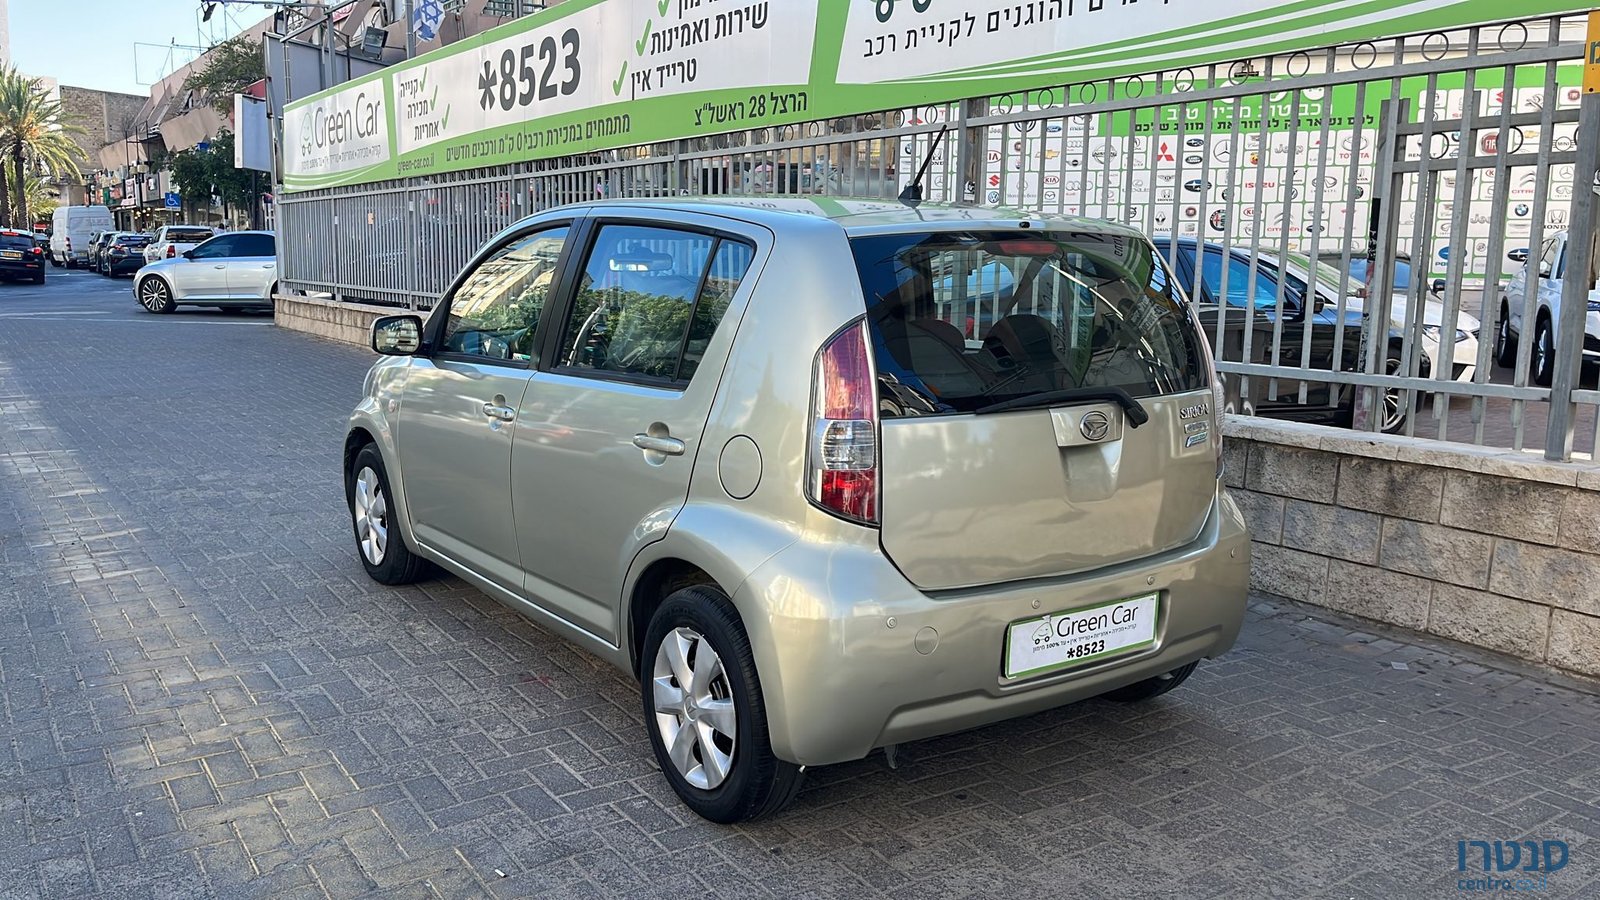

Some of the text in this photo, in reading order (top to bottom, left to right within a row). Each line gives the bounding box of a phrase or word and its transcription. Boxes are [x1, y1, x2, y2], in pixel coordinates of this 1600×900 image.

[714, 1, 768, 40] שירות
[905, 12, 976, 49] לקניית
[650, 18, 710, 56] ואמינות
[864, 33, 896, 57] רכב
[400, 78, 418, 99] קנייה
[630, 58, 697, 100] טרייד אין
[407, 99, 429, 119] מכירה
[749, 95, 766, 118] 28
[770, 91, 807, 114] הרצל
[1258, 103, 1291, 119] טו
[1299, 103, 1332, 116] כב
[315, 92, 380, 149] Green Car
[1167, 107, 1198, 120] טב
[1284, 118, 1301, 129] ק
[1348, 115, 1374, 125] לם
[414, 120, 440, 141] אחריות
[546, 124, 583, 147] במכירת
[586, 113, 630, 139] מתמחים
[1135, 122, 1169, 132] שכם
[472, 139, 497, 157] ורכבים
[524, 131, 544, 150] רכבי
[1275, 144, 1303, 155] Jep
[397, 152, 435, 175] green-car.co.il
[446, 144, 470, 162] חדשים
[1180, 403, 1209, 419] SIRION
[1057, 605, 1139, 638] Green Car
